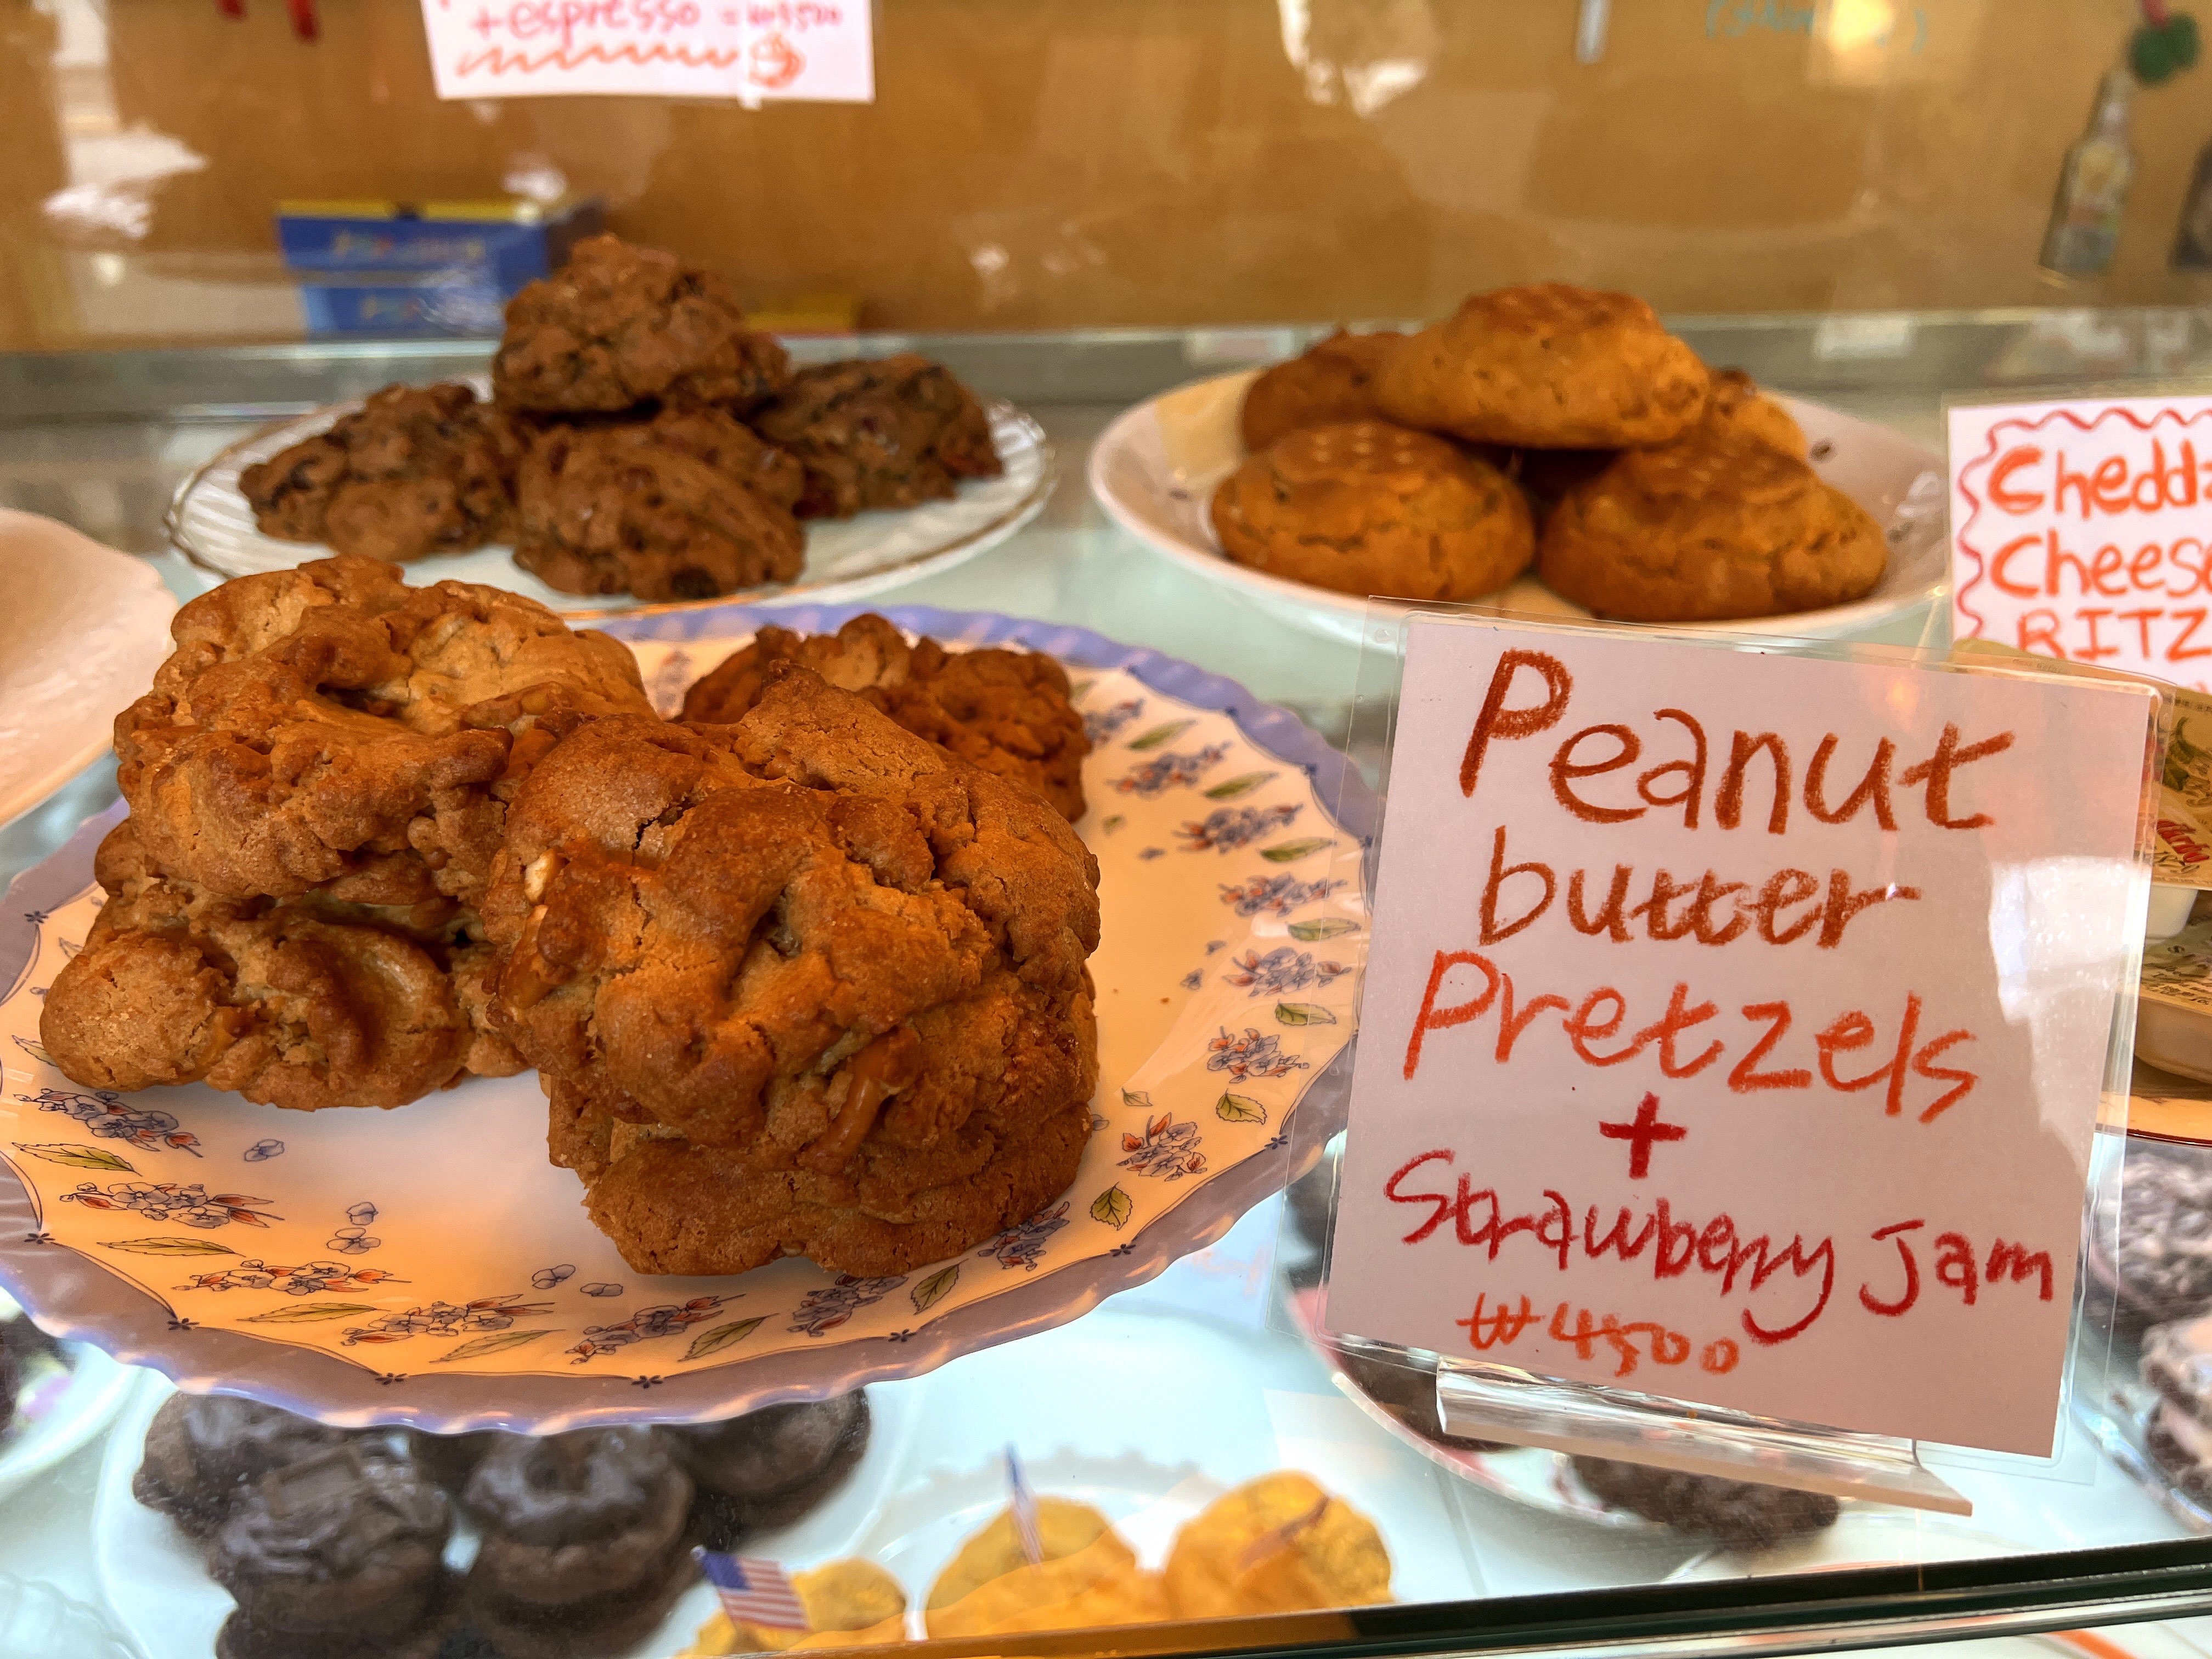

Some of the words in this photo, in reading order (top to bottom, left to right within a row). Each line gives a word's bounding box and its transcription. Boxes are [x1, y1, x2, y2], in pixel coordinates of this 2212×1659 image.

[1989, 527, 2212, 599] Chees
[2017, 608, 2212, 662] RITZ
[1459, 648, 2015, 835] Peanut
[1479, 825, 1921, 949] butter
[1402, 949, 1978, 1124] Pretzels
[1384, 1149, 1836, 1347] Strawberry
[1859, 1218, 2055, 1318] Jam
